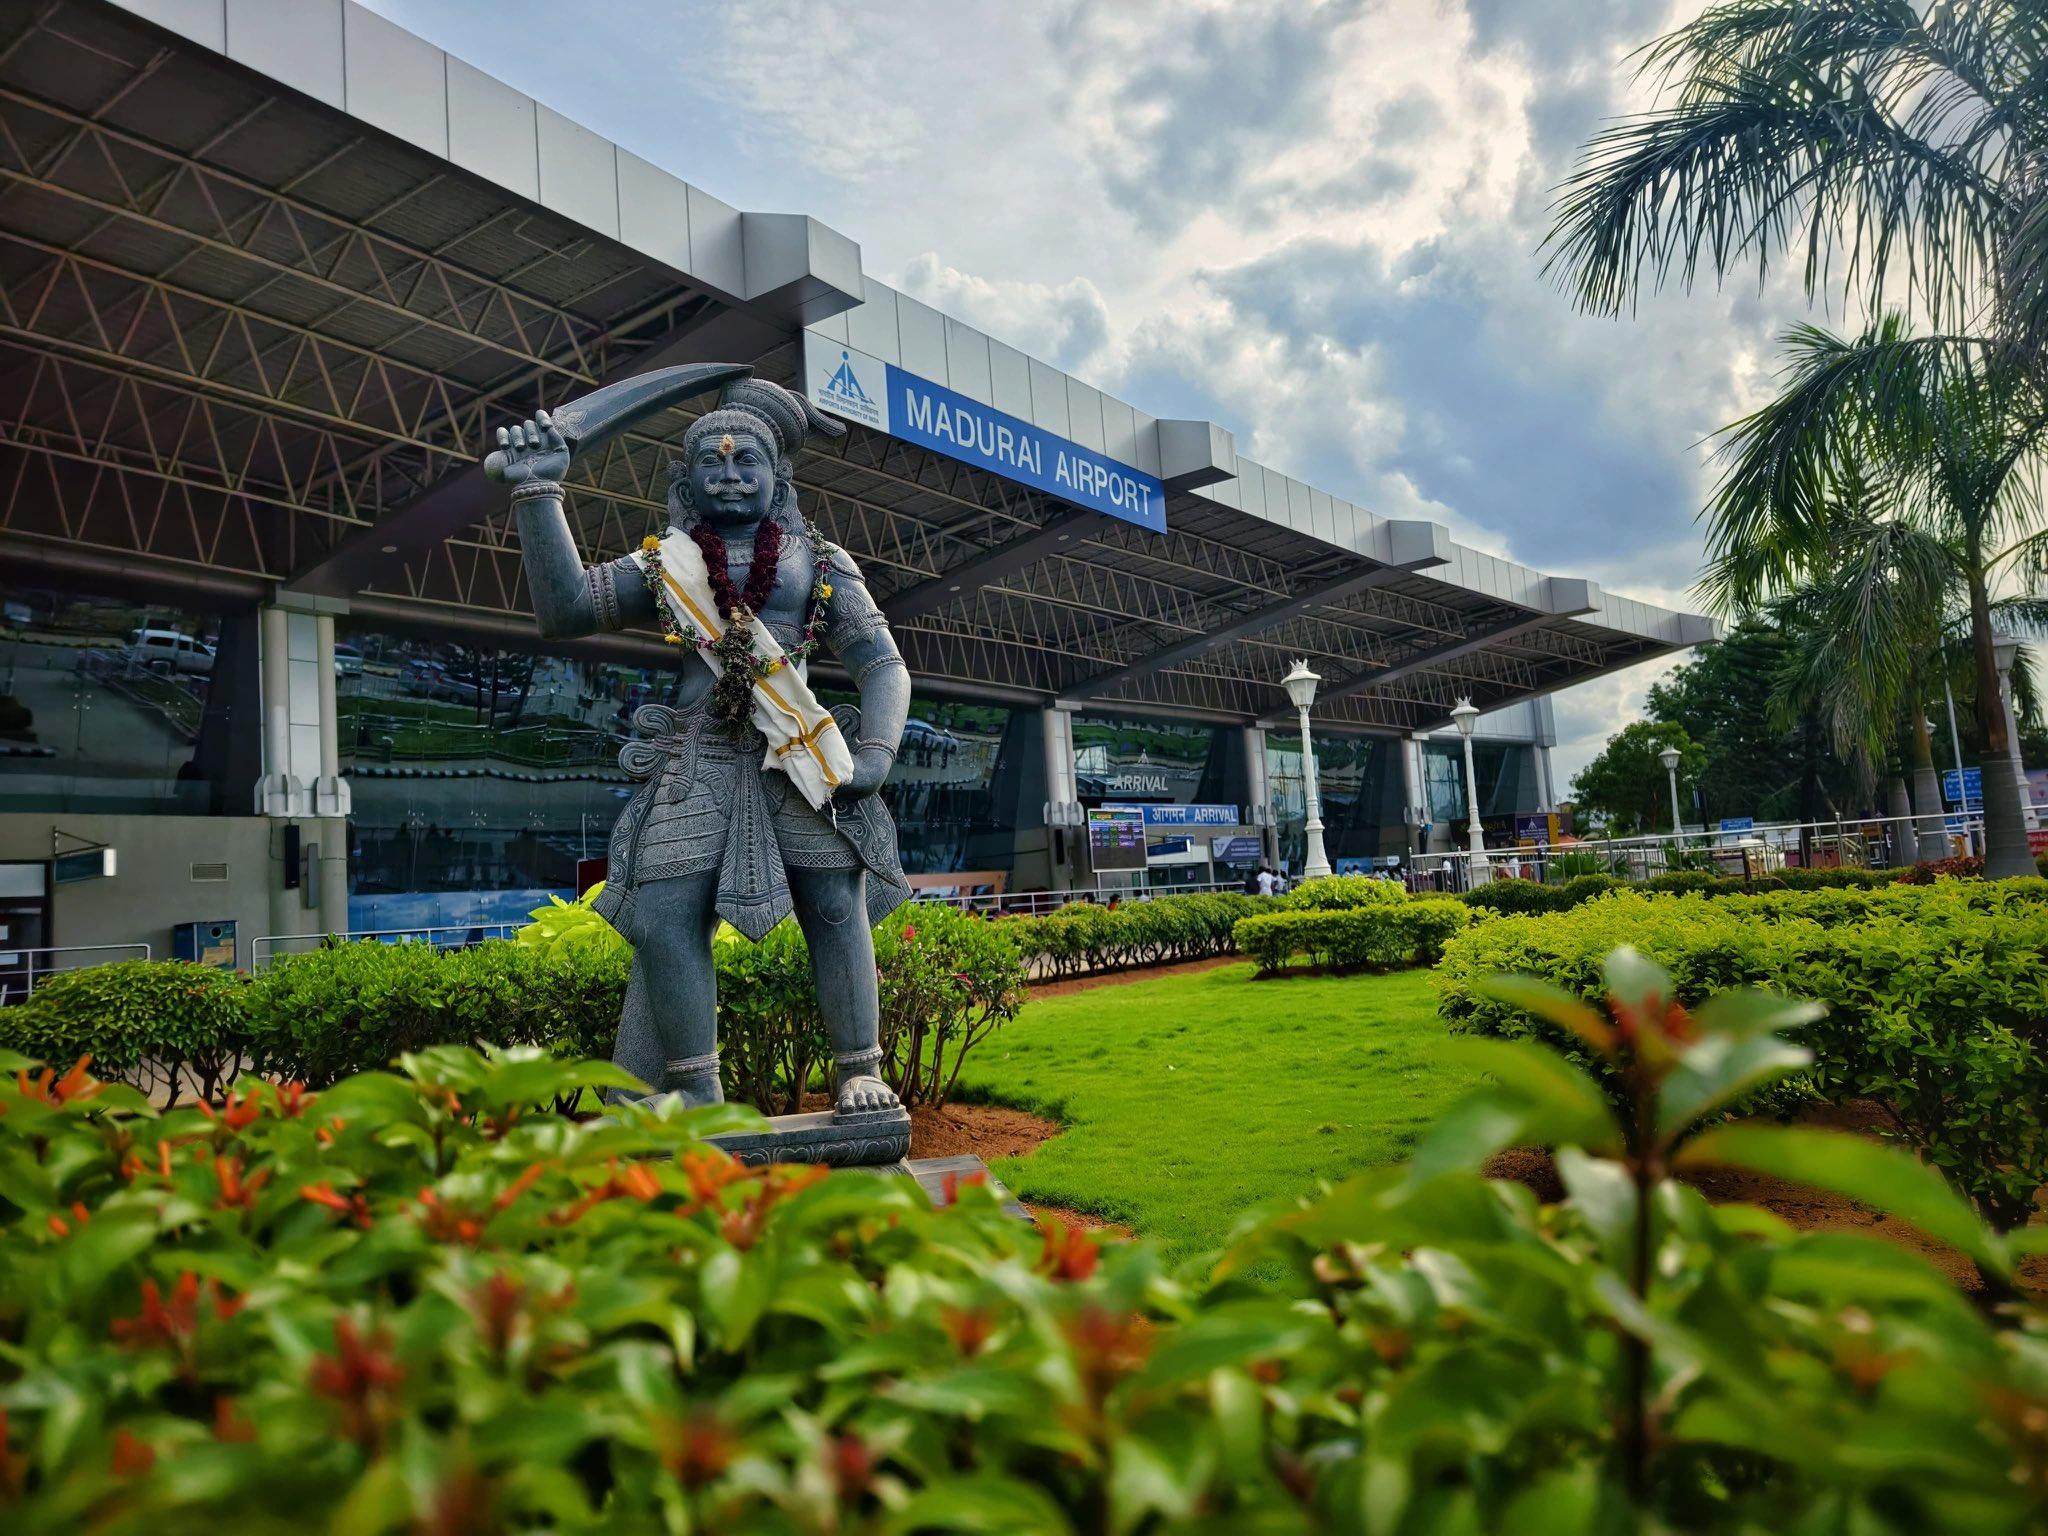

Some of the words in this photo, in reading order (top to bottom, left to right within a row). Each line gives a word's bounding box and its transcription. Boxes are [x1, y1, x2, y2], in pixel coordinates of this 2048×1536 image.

[906, 388, 1042, 475] MADURAI
[1055, 450, 1151, 516] AIRPORT
[1113, 775, 1168, 792] ARRIVAL
[1152, 807, 1187, 823] आगमन
[1194, 807, 1237, 823] ARRIVAL
